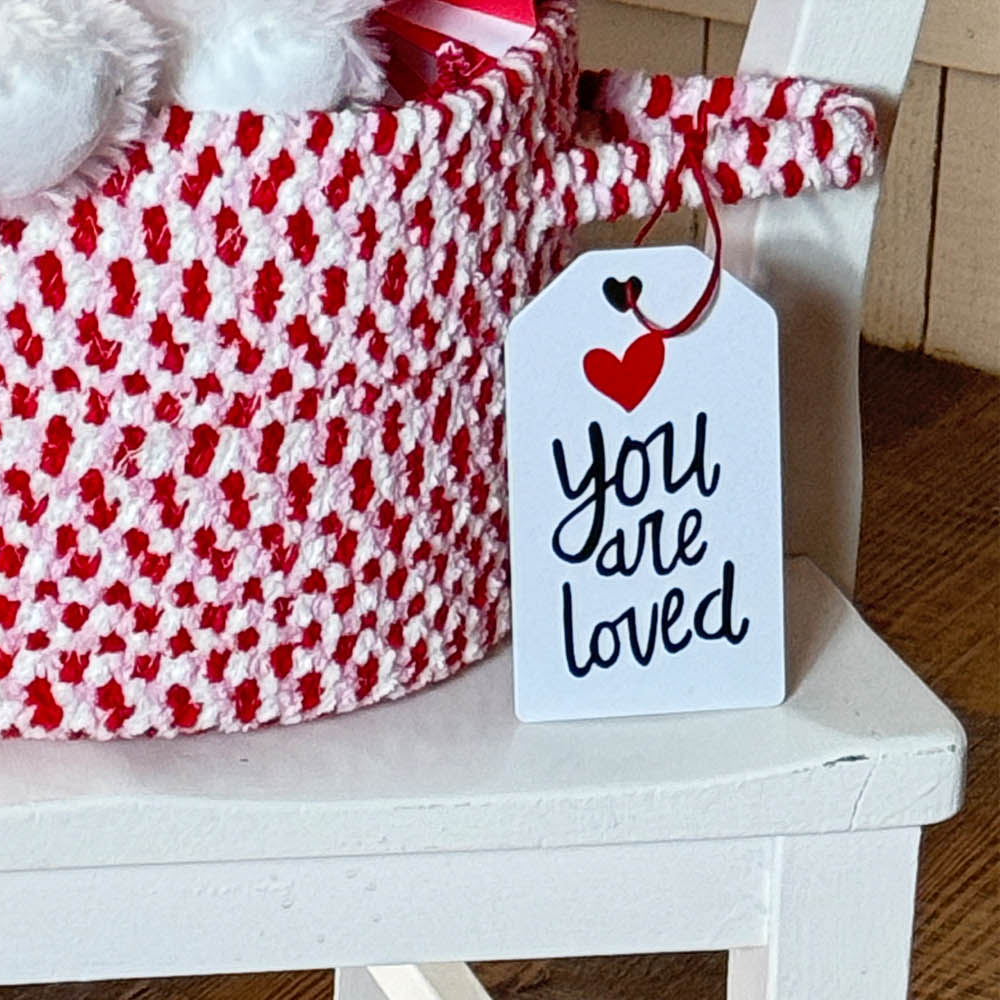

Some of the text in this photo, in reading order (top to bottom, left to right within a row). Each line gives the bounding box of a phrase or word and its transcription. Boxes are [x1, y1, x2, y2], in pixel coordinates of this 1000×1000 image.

[552, 411, 721, 563] you
[596, 508, 708, 577] are
[562, 560, 750, 678] loved
